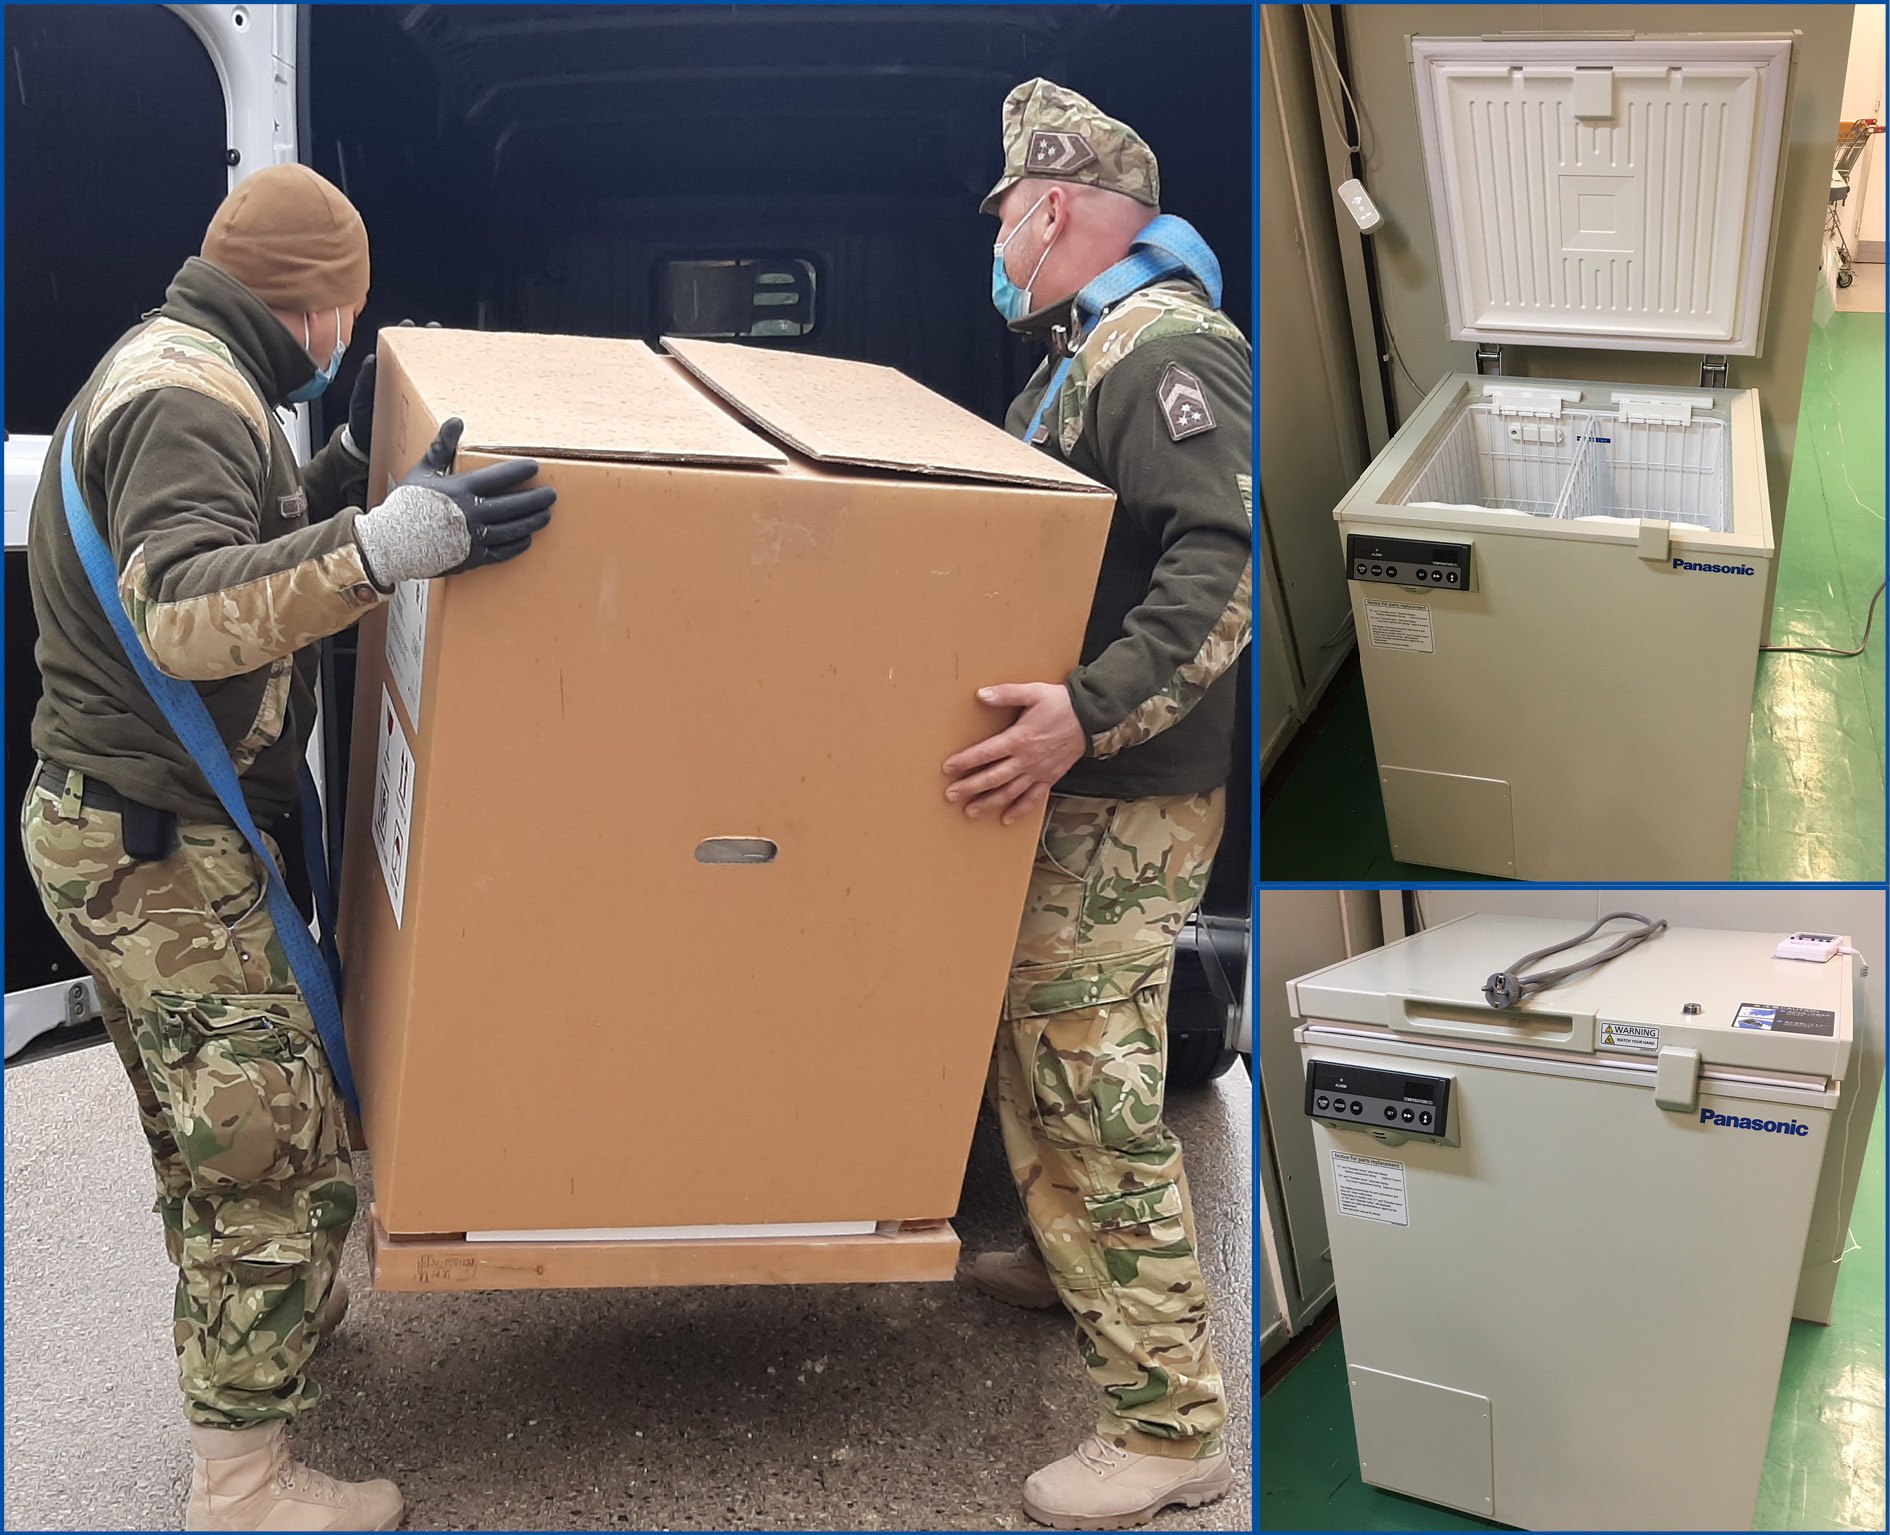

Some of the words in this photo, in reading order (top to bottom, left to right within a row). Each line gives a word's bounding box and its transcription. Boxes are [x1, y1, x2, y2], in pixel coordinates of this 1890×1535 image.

[1673, 558, 1755, 576] Panasonic
[1614, 1025, 1656, 1037] WARNING
[1699, 1107, 1809, 1137] Panasonic
[1370, 1159, 1401, 1168] replacement
